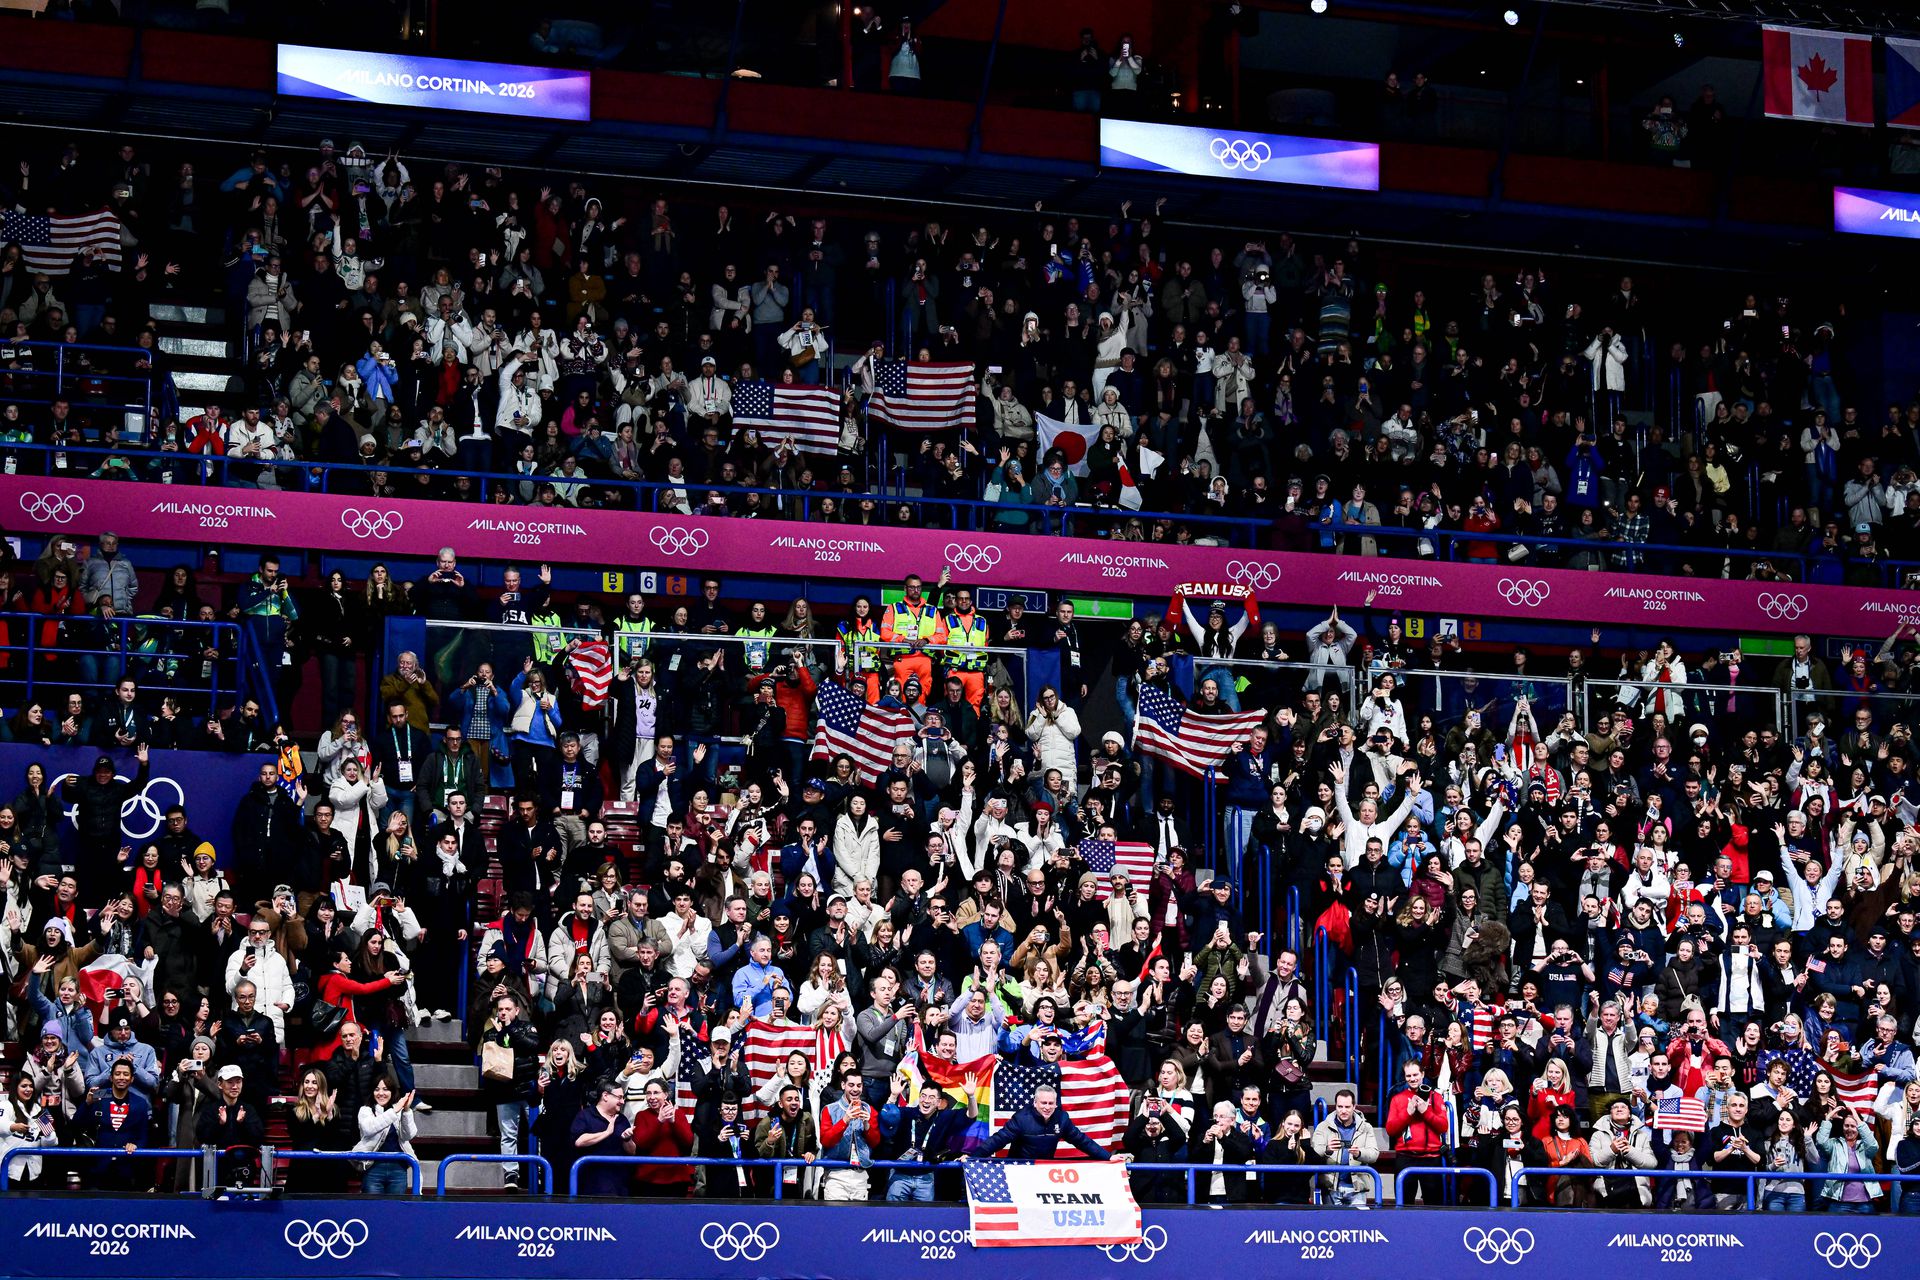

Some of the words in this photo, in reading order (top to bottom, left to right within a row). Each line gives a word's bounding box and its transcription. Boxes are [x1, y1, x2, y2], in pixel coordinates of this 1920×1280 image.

[336, 69, 414, 89] MILANO
[416, 75, 496, 96] CORTINA
[498, 82, 536, 99] 2026
[1880, 207, 1920, 223] MILA
[151, 502, 212, 515] MILANO
[214, 505, 277, 518] CORTINA
[199, 516, 229, 528] 2026
[467, 519, 526, 532] MILANO
[527, 522, 588, 536] CORTINA
[513, 533, 541, 545] 2026
[769, 536, 826, 549] MILANO
[828, 539, 886, 553] CORTINA
[814, 550, 841, 562] 2026
[1059, 552, 1113, 566] MILANO
[1114, 556, 1169, 569] CORTINA
[608, 572, 618, 583] B
[1101, 566, 1127, 578] 2026
[1337, 570, 1389, 583] MILANO
[1390, 574, 1443, 588] CORTINA
[643, 576, 654, 589] 6
[671, 583, 681, 594] C
[1378, 584, 1403, 597] 2026
[1604, 587, 1653, 599] MILANO
[1654, 590, 1706, 603] CORTINA
[1643, 600, 1667, 611] 2026
[1859, 601, 1907, 614] MILANO
[1410, 618, 1419, 628] B
[1444, 622, 1454, 635] 7
[1548, 973, 1565, 982] USA
[1048, 1168, 1080, 1184] GO
[1036, 1192, 1104, 1205] TEAM
[1052, 1209, 1105, 1227] USA!
[23, 1222, 108, 1238] MILANO
[111, 1223, 196, 1239] CORTINA
[455, 1225, 534, 1241] MILANO
[537, 1226, 617, 1241] CORTINA
[861, 1228, 936, 1244] MILANO
[1244, 1230, 1315, 1244] MILANO
[1317, 1229, 1390, 1244] CORTINA
[1607, 1233, 1674, 1247] MILANO
[1676, 1233, 1744, 1247] CORTINA
[90, 1240, 130, 1255] 2026
[517, 1243, 555, 1258] 2026
[920, 1245, 956, 1260] 2026
[1301, 1245, 1335, 1259] 2026
[1660, 1248, 1693, 1262] 2026
